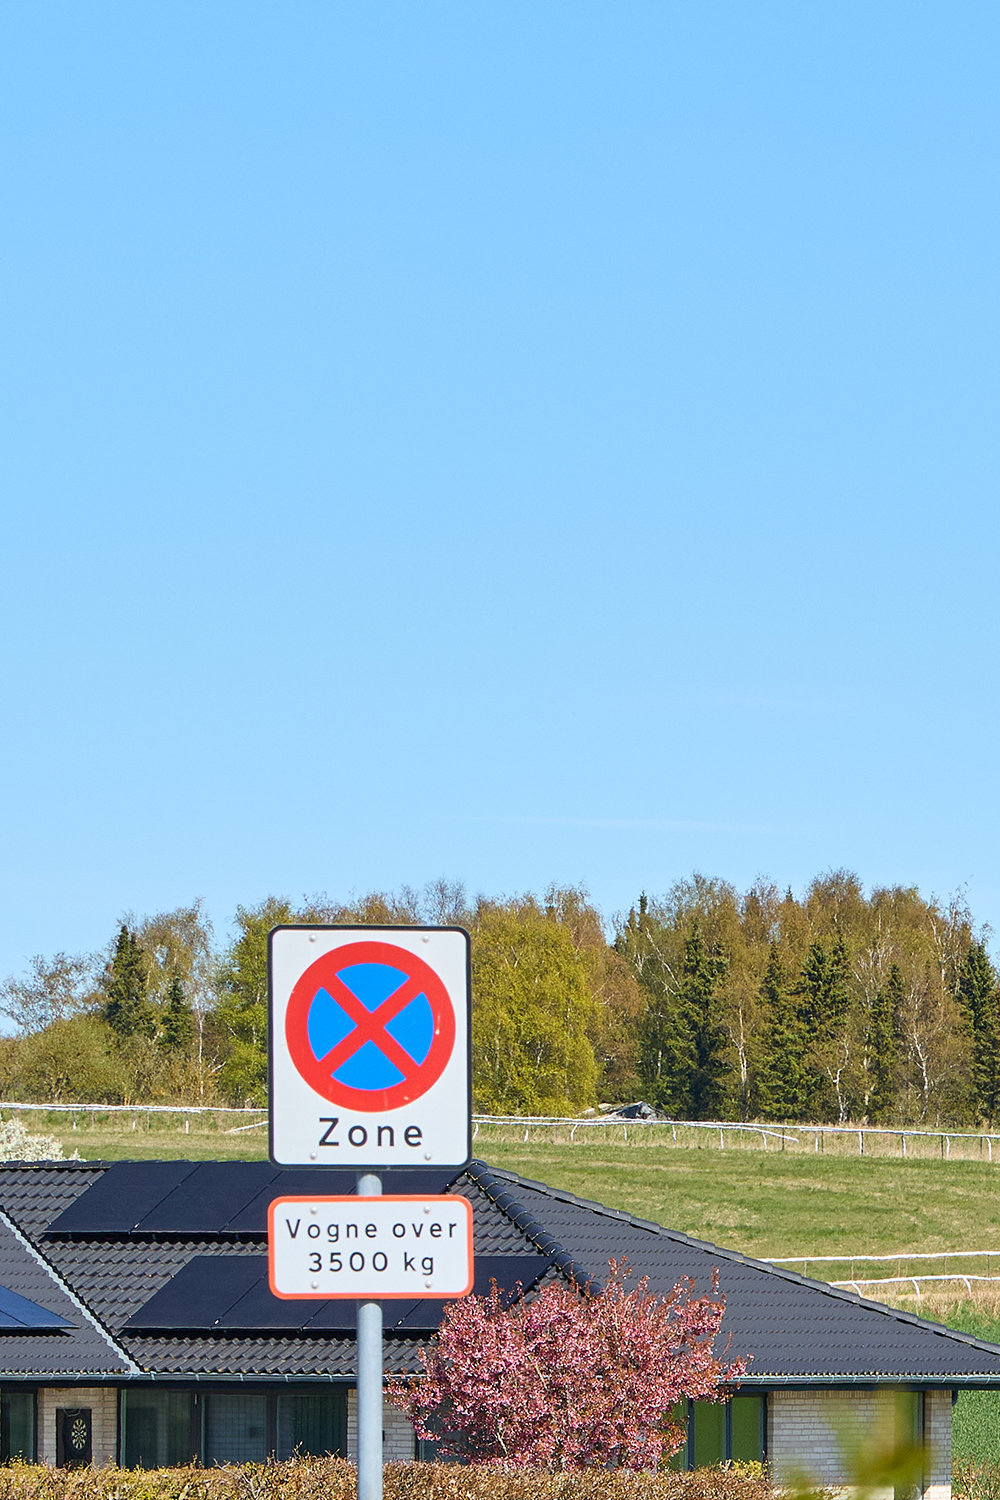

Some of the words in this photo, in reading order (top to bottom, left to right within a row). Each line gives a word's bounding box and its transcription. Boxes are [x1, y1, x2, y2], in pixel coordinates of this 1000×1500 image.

[318, 1117, 423, 1147] Zone
[285, 1218, 378, 1243] Vogne
[391, 1222, 457, 1239] over
[308, 1251, 389, 1273] 3500
[403, 1252, 435, 1275] kg
